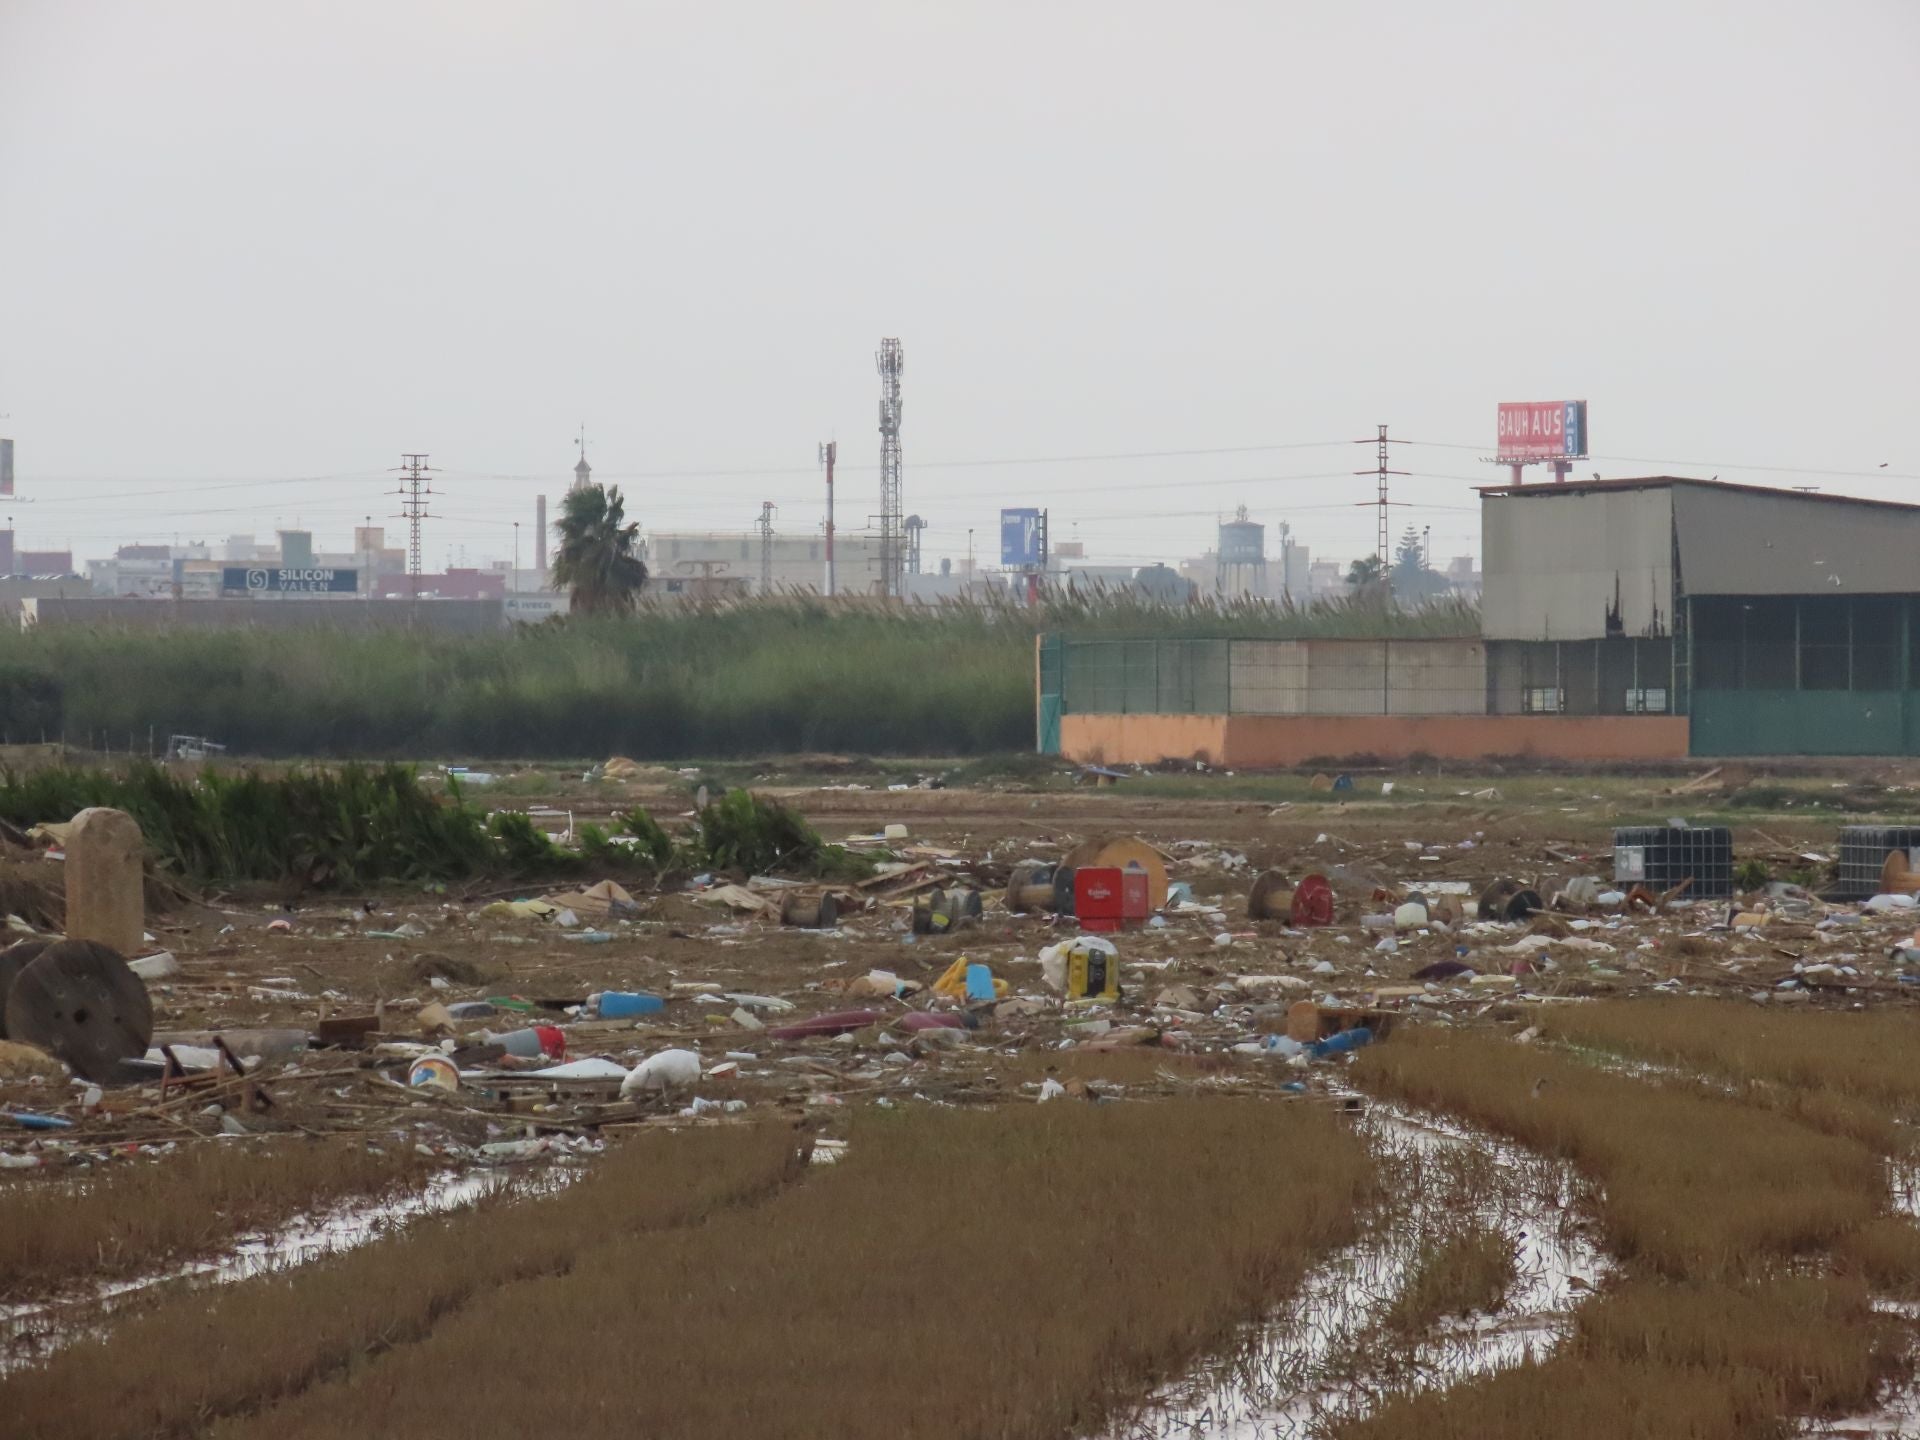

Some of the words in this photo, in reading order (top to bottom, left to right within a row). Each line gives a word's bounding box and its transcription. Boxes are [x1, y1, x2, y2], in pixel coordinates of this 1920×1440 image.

[1499, 409, 1561, 436] BAUHAUS
[278, 569, 334, 581] SILICON
[279, 582, 329, 592] VALEN
